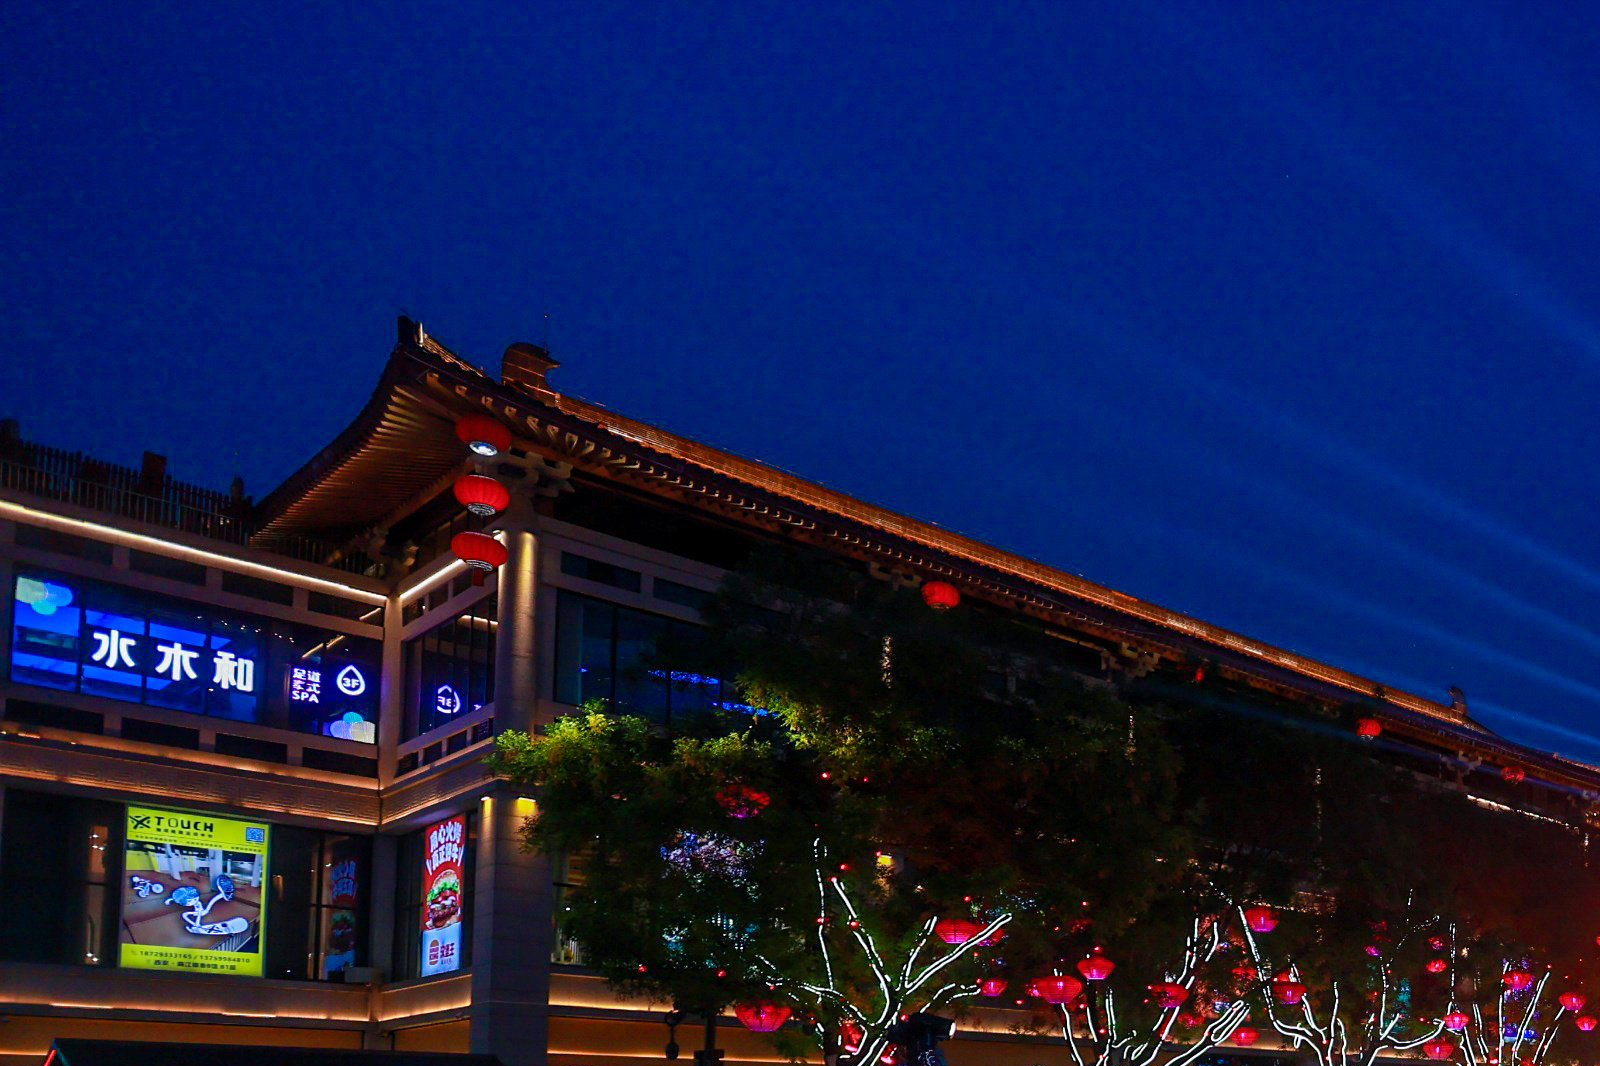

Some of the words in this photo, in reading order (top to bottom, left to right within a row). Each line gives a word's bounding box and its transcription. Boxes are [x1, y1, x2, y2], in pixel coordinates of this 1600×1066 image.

[91, 629, 254, 692] 水木和
[342, 677, 360, 688] 3F
[292, 690, 319, 703] SPA
